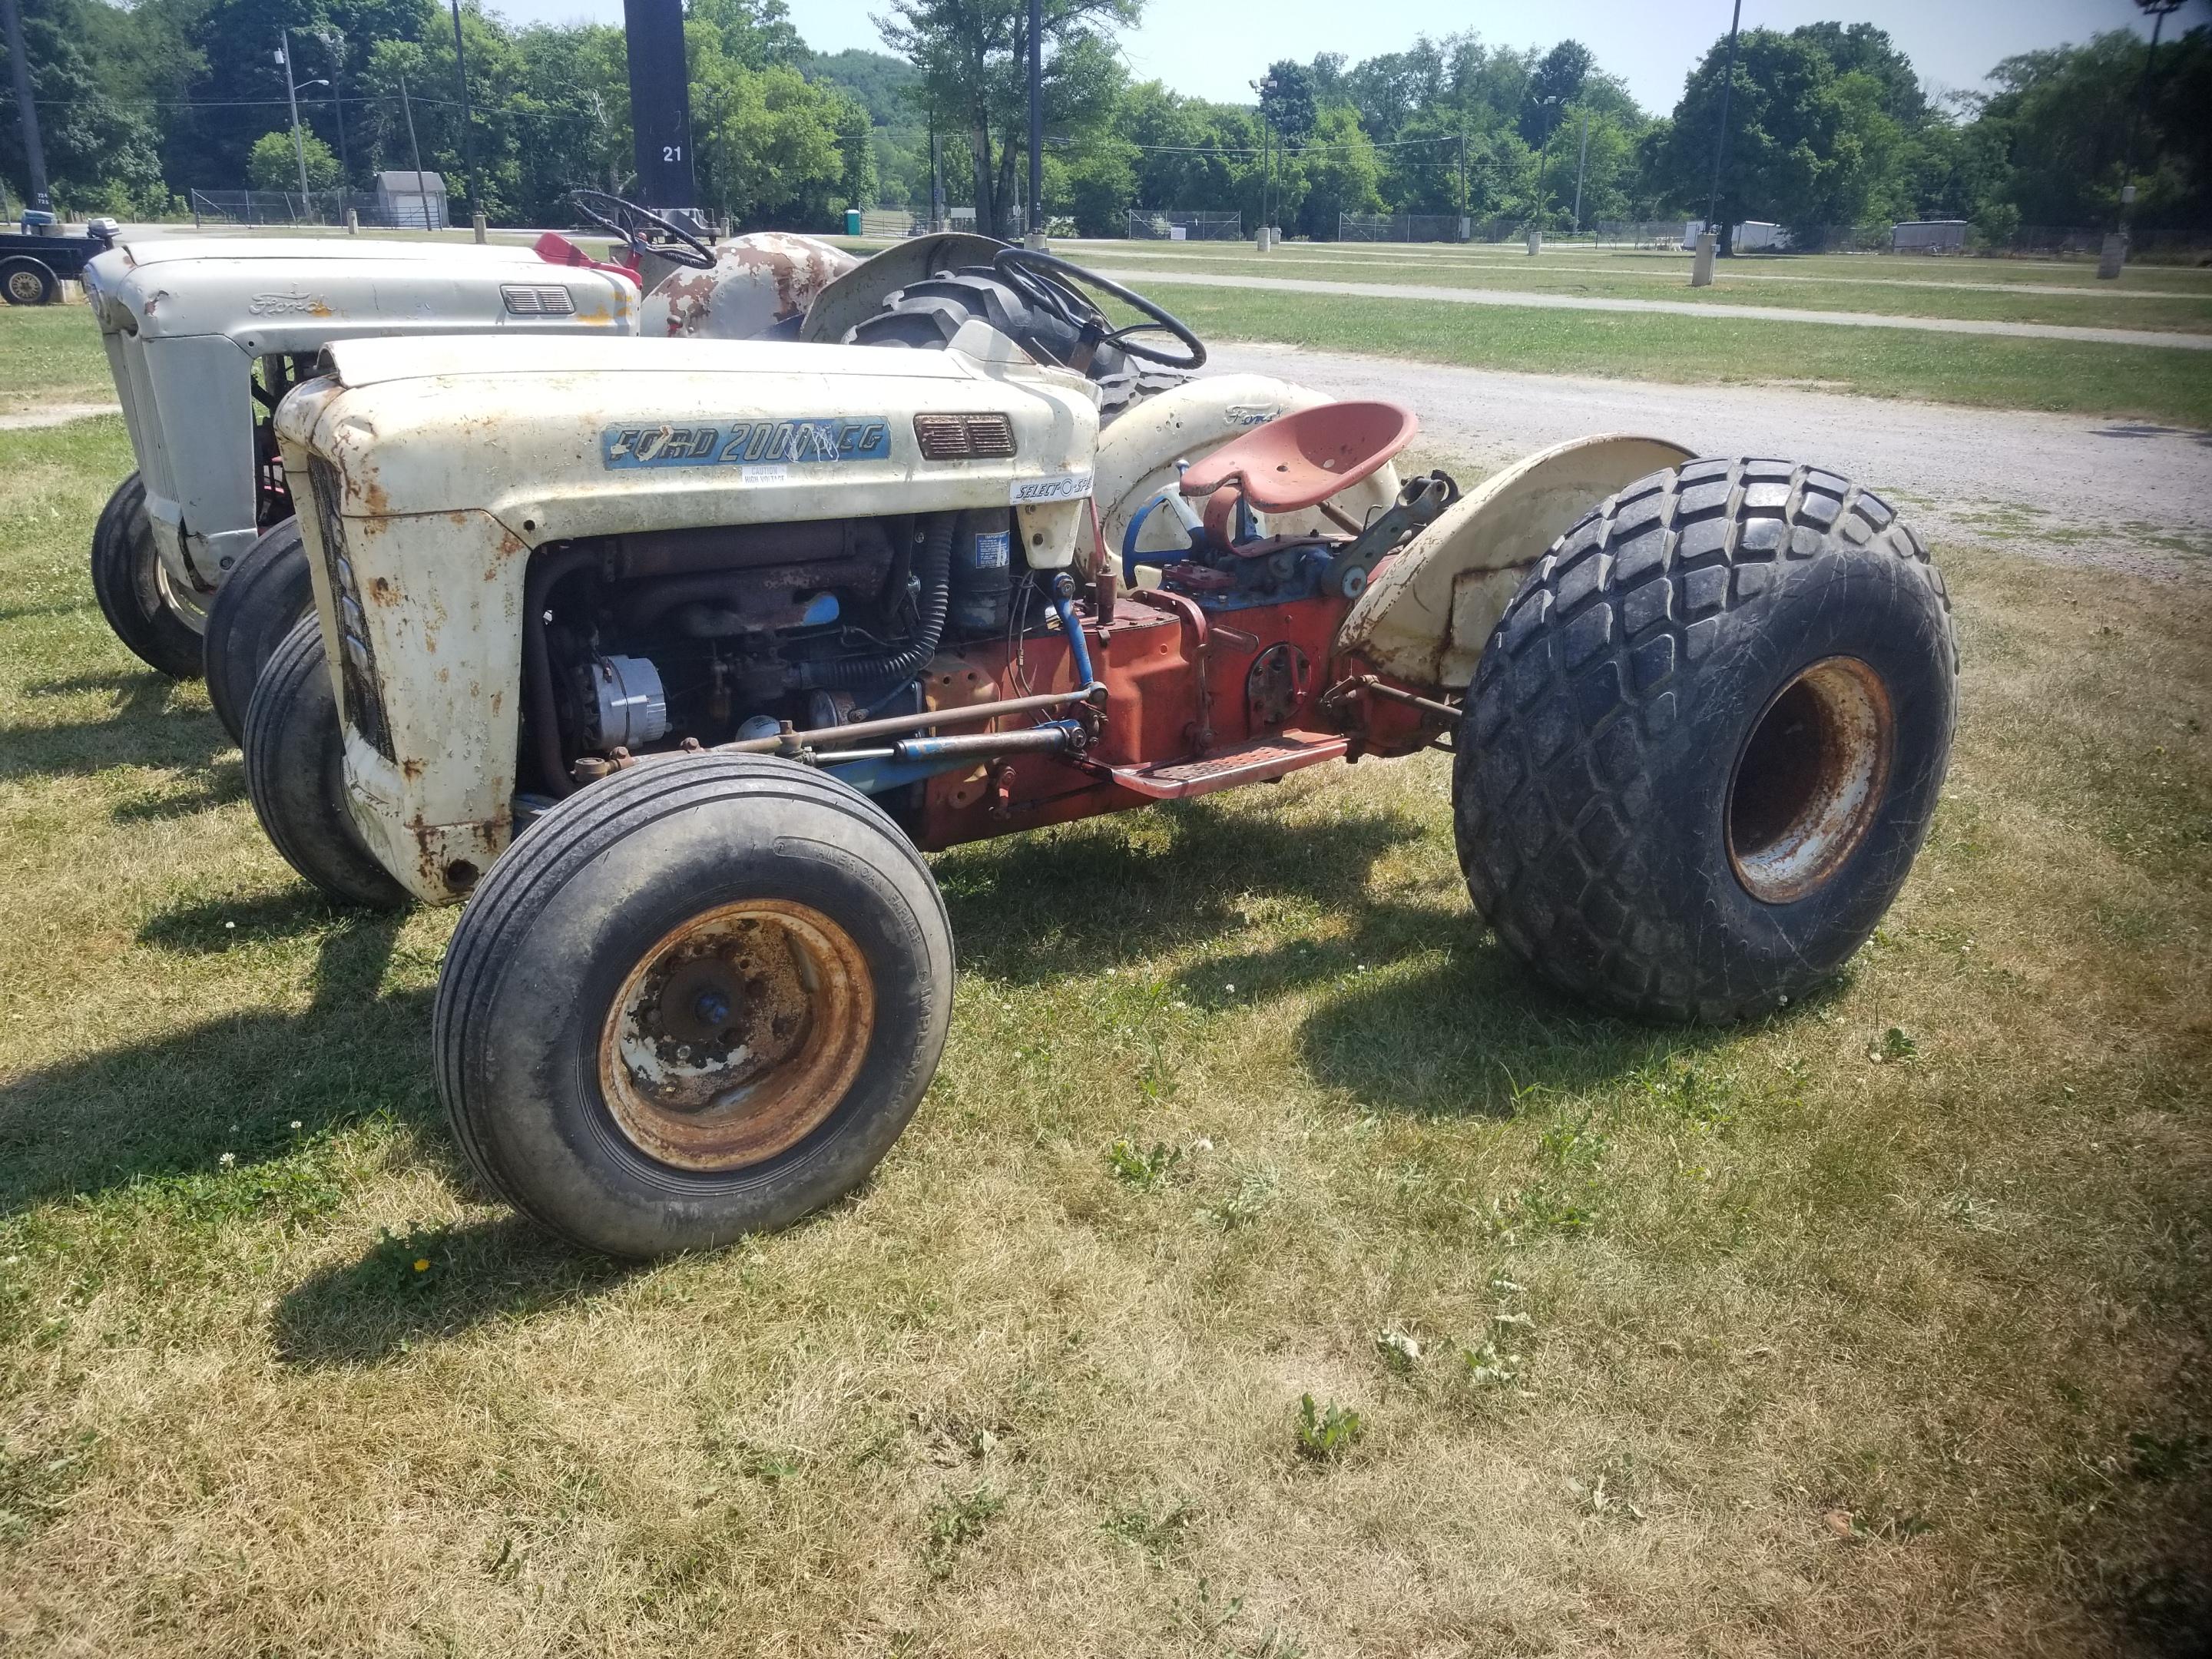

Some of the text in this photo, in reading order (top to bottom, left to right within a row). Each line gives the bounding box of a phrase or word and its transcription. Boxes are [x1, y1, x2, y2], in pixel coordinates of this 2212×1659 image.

[663, 146, 680, 161] 21
[249, 292, 336, 316] Ford
[609, 426, 719, 462] FORD
[719, 422, 814, 462] 2000
[752, 466, 777, 475] CAUTION
[744, 475, 759, 484] HIGH
